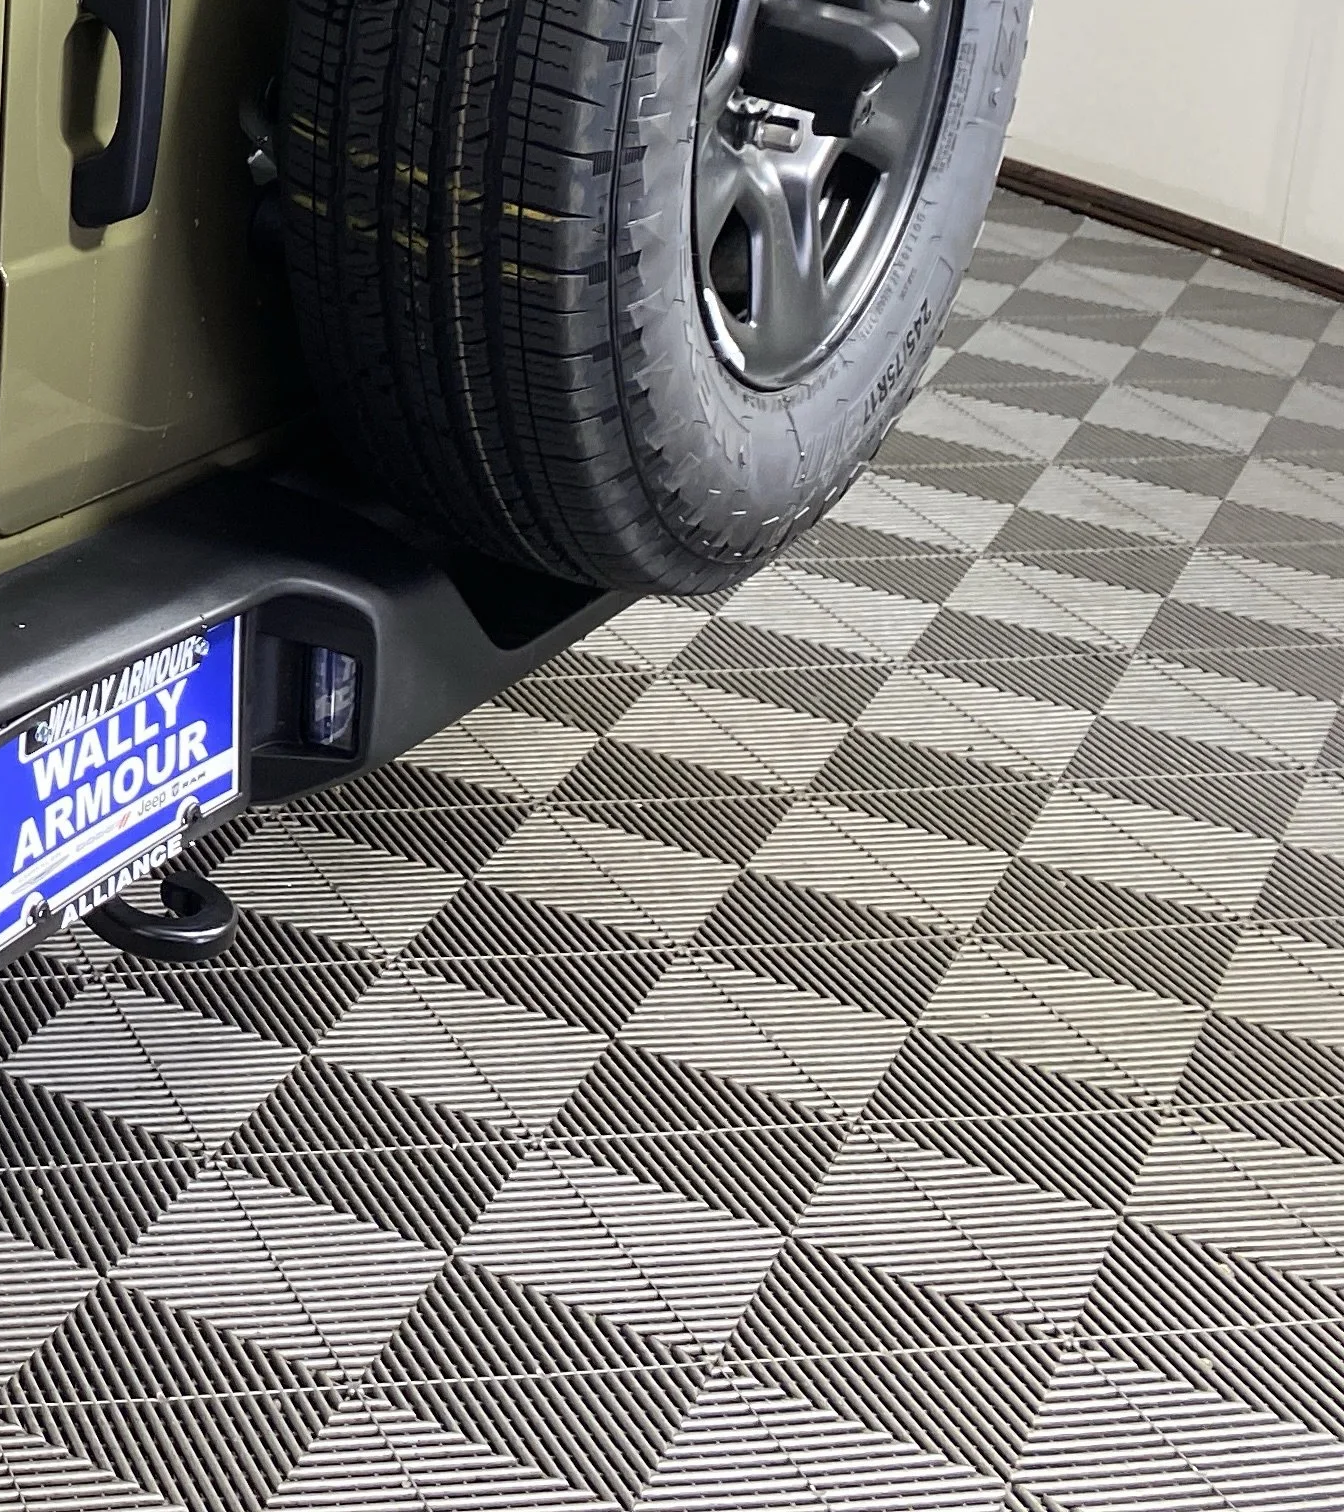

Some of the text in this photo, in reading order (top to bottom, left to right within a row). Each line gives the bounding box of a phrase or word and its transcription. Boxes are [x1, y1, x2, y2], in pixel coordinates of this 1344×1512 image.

[862, 297, 933, 425] 245/75R17
[33, 678, 188, 801] WALLY
[47, 635, 199, 746] WALLY ARMOUR
[12, 720, 209, 874] ARMOUR
[138, 791, 166, 817] Jeep
[182, 771, 206, 788] RAM
[61, 834, 183, 929] ALLIANCE
